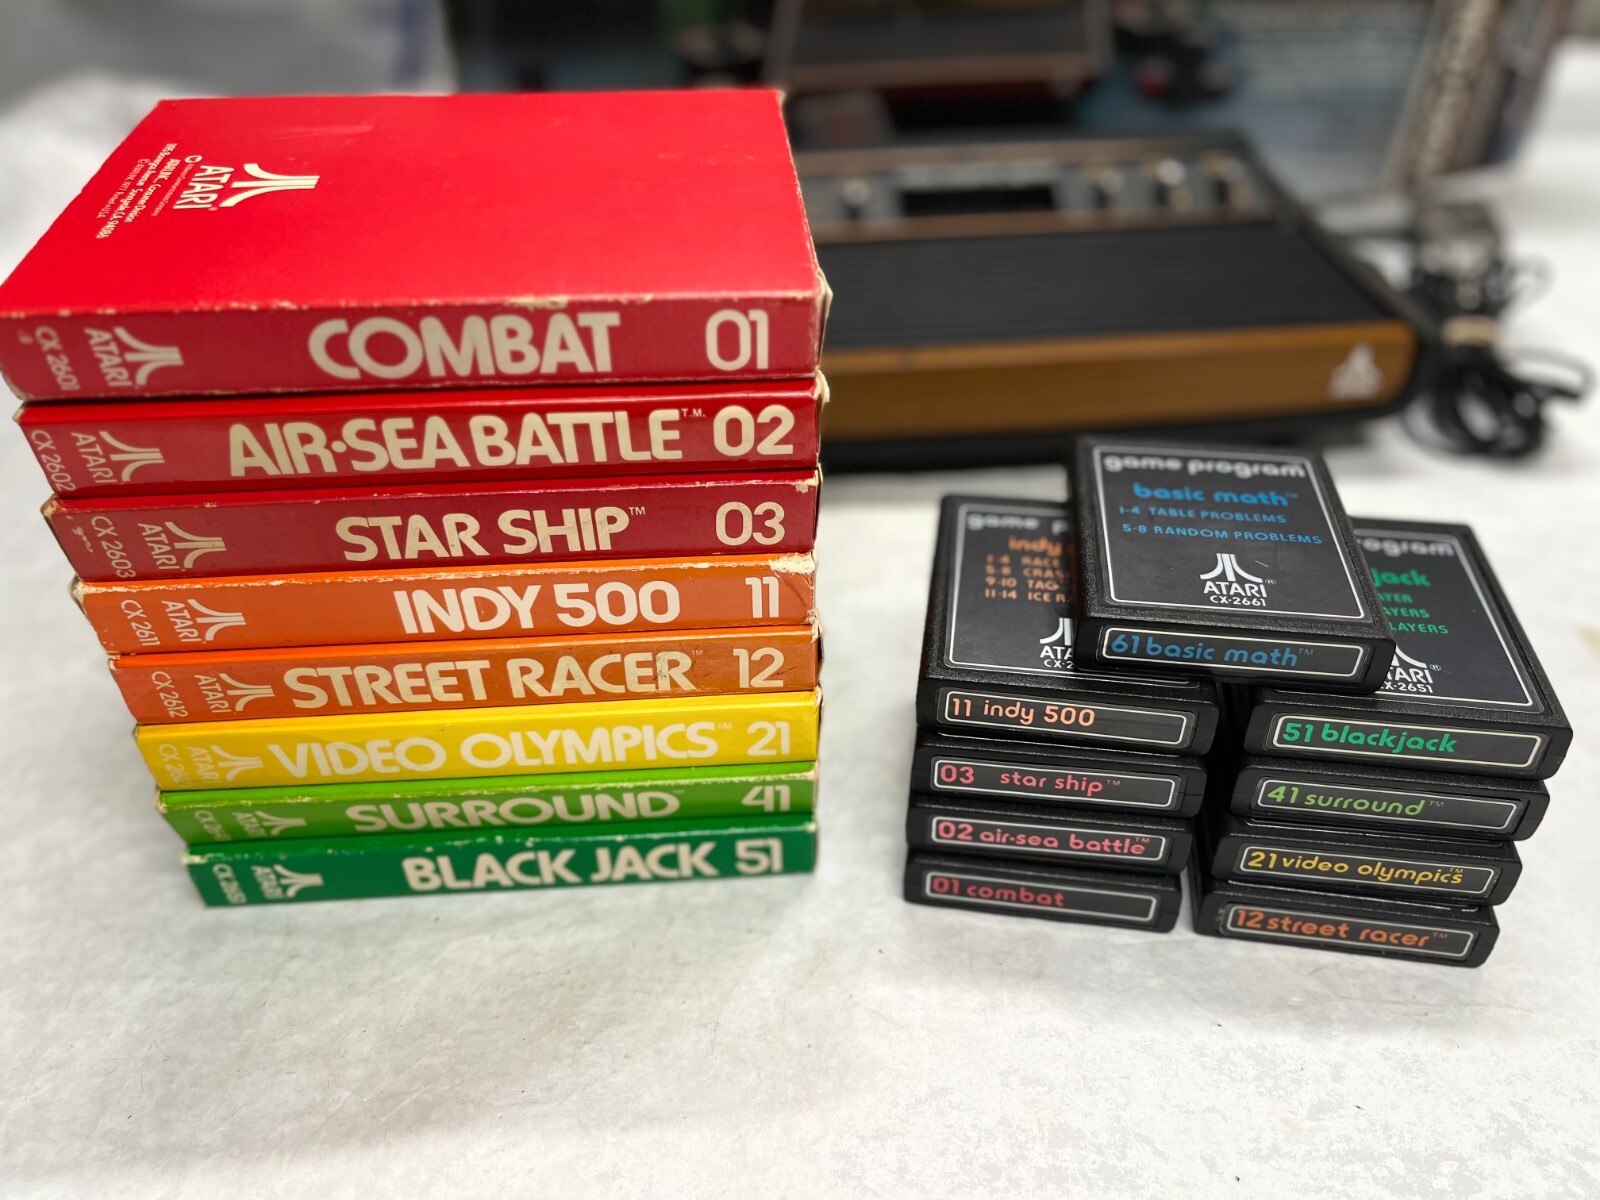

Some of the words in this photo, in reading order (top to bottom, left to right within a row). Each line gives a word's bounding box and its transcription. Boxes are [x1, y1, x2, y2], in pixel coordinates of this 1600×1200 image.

[136, 183, 162, 205] Consumer
[173, 165, 235, 209] ATARI
[93, 220, 120, 238] 94086
[123, 205, 146, 222] Division
[35, 326, 62, 348] CX
[308, 311, 621, 380] COMBAT
[705, 308, 770, 372] 01
[46, 345, 80, 390] 2601
[84, 327, 133, 387] ATARI
[30, 429, 56, 452] CX
[470, 408, 684, 467] BATTLE
[713, 404, 795, 457] 02
[41, 452, 76, 493] 2602
[71, 432, 117, 483] ATARI
[1103, 455, 1183, 473] game
[1187, 459, 1307, 479] program
[1132, 481, 1205, 503] basic
[1213, 490, 1289, 508] math
[91, 515, 116, 540] CX
[967, 514, 1040, 531] game
[1119, 505, 1141, 516] 1-4
[1148, 506, 1196, 519] TABLE
[1200, 511, 1287, 525] PROBLEMS
[138, 522, 181, 570] ATARI
[336, 511, 490, 562] STAR
[498, 506, 630, 555] SHIP
[715, 501, 786, 546] 03
[1008, 537, 1063, 558] indy
[1122, 524, 1147, 534] 5-8
[1153, 525, 1229, 539] RANDOM
[1233, 532, 1323, 545] PROBLEMS
[102, 538, 137, 579] 2603
[1027, 579, 1060, 591] TAG
[1027, 592, 1052, 603] ICE
[1203, 580, 1268, 598] ATARI
[121, 599, 144, 620] CX
[394, 585, 542, 633] INDY
[554, 580, 680, 627] 500
[745, 576, 780, 618] 11
[130, 619, 160, 647] 2611
[161, 600, 203, 642] ATARI
[1111, 634, 1139, 654] 61
[1146, 638, 1214, 661] basic
[1223, 648, 1299, 667] math
[151, 670, 176, 690] CX
[195, 674, 233, 714] ATARI
[284, 659, 490, 709] STREET
[507, 651, 697, 698] RACER
[733, 647, 784, 689] 12
[161, 687, 189, 719] 2612
[952, 698, 971, 716] 11
[983, 700, 1034, 725] indy
[1043, 705, 1095, 727] 500
[159, 743, 181, 761] CX
[268, 736, 448, 779] VIDEO
[460, 722, 719, 769] OLYMPICS
[747, 721, 791, 757] 21
[1282, 723, 1313, 743] 51
[1321, 724, 1457, 753] blackjack
[186, 745, 222, 784] ATARI
[940, 764, 975, 785] 03
[1000, 770, 1047, 788] star
[1054, 775, 1103, 797] ship
[345, 790, 680, 833] SURROUND
[741, 784, 792, 813] 41
[1267, 786, 1297, 804] 41
[1305, 793, 1425, 816] surround
[937, 821, 974, 841] 02
[1069, 833, 1146, 855] battle
[212, 863, 235, 882] CX
[401, 850, 582, 892] BLACK
[590, 841, 719, 884] JACK
[734, 838, 784, 875] 51
[1247, 851, 1277, 869] 21
[1282, 855, 1349, 874] video
[1357, 862, 1464, 885] olympics
[252, 864, 285, 900] ATARI
[931, 876, 960, 894] 01
[966, 880, 1065, 907] combat
[1235, 909, 1264, 929] 12
[1267, 918, 1348, 939] street
[1359, 926, 1430, 948] racer
